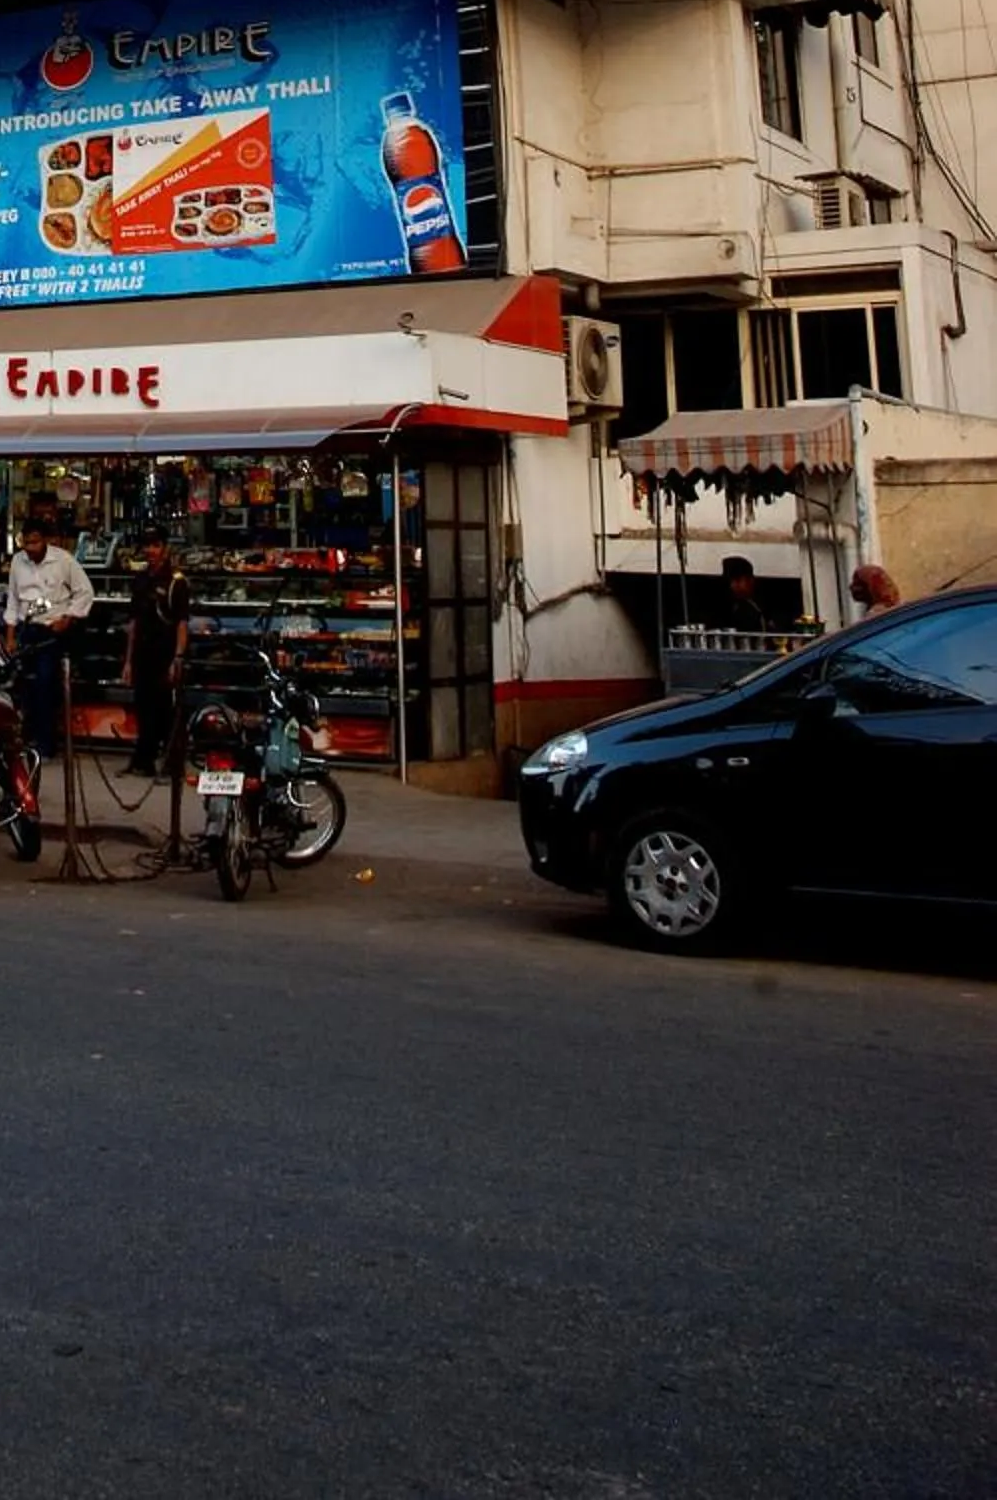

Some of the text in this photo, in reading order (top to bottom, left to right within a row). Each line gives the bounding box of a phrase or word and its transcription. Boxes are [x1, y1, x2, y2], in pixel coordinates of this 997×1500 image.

[110, 21, 274, 66] EMPIRE
[130, 95, 183, 117] TAKE
[199, 85, 259, 109] AWAY
[267, 76, 332, 100] THALI
[406, 214, 450, 238] PEPSI
[67, 263, 84, 277] 40
[88, 261, 104, 276] 41
[108, 260, 124, 275] 41
[129, 259, 145, 273] 41
[37, 280, 75, 296] WITH
[79, 279, 88, 293] 2
[94, 275, 145, 292] THALIS
[6, 358, 160, 408] EMPIRE
